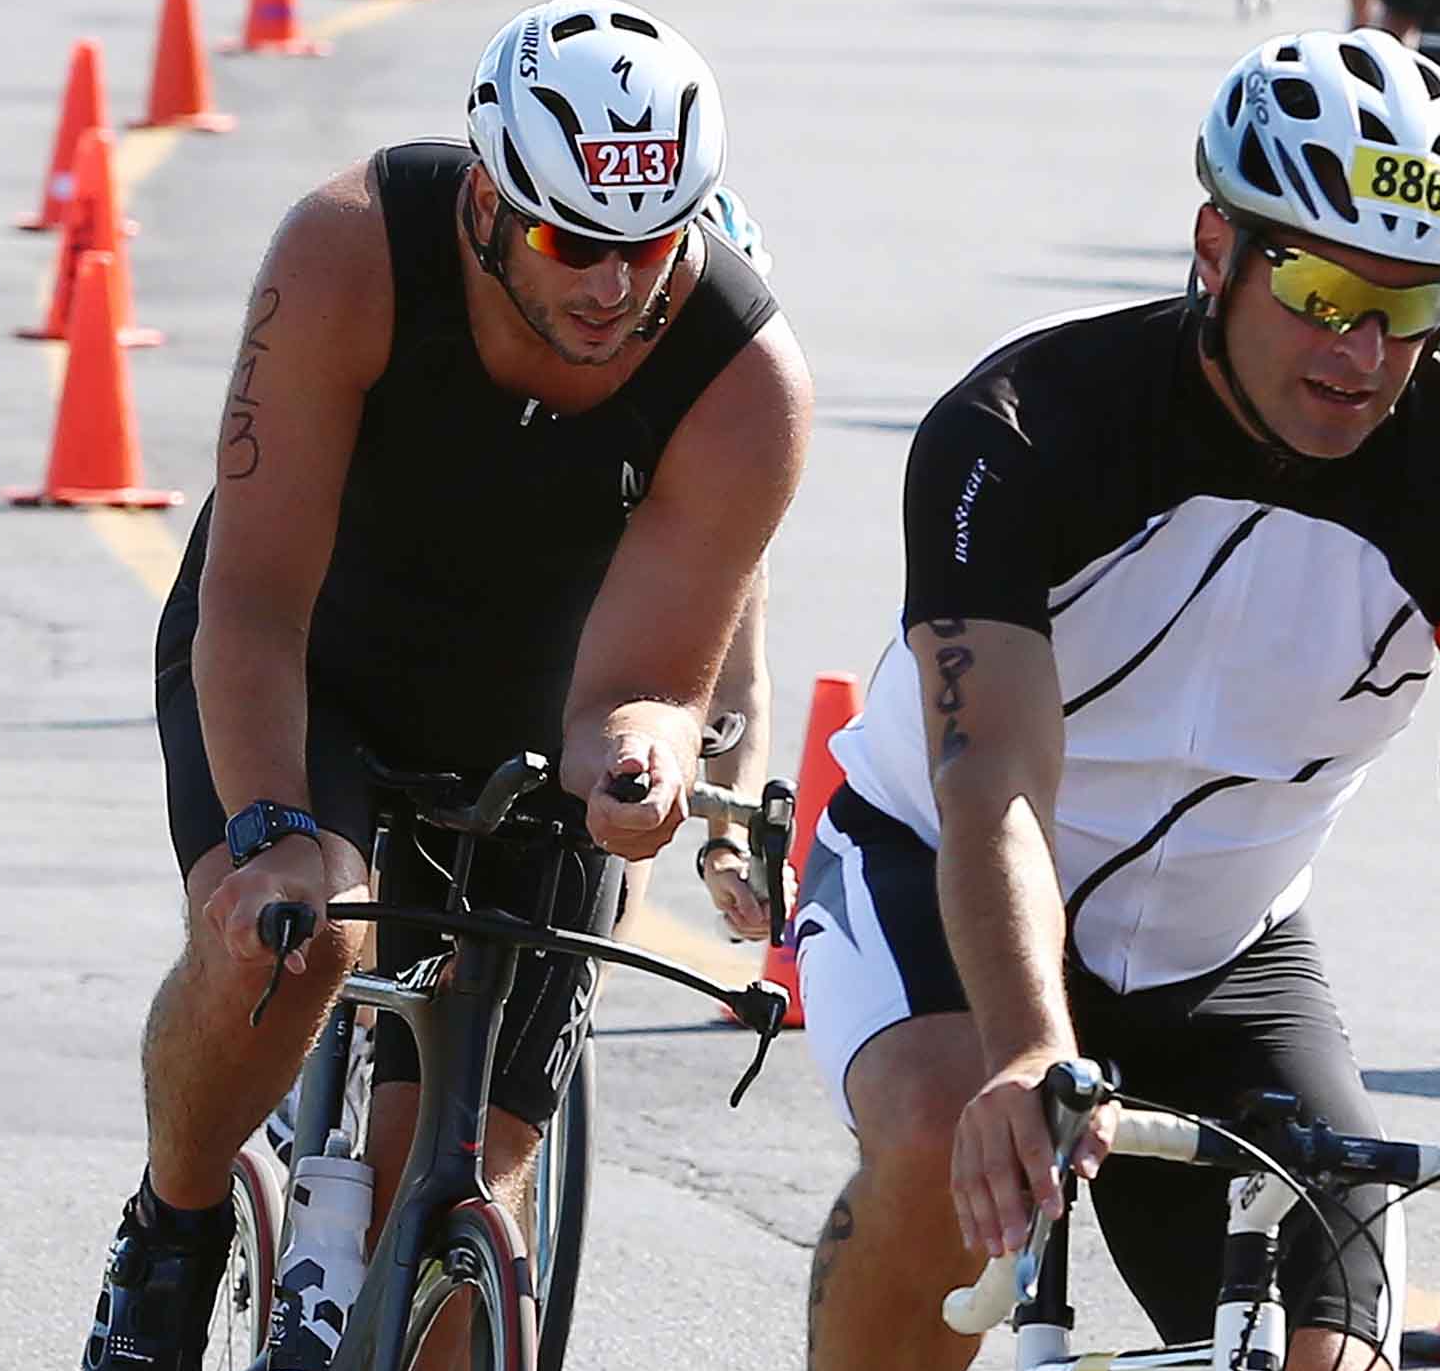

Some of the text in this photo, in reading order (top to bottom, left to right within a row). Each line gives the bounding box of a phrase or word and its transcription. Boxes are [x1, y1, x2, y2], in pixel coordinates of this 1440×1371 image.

[597, 142, 667, 185] 213
[224, 286, 281, 480] 213
[543, 956, 598, 1091] 2XU
